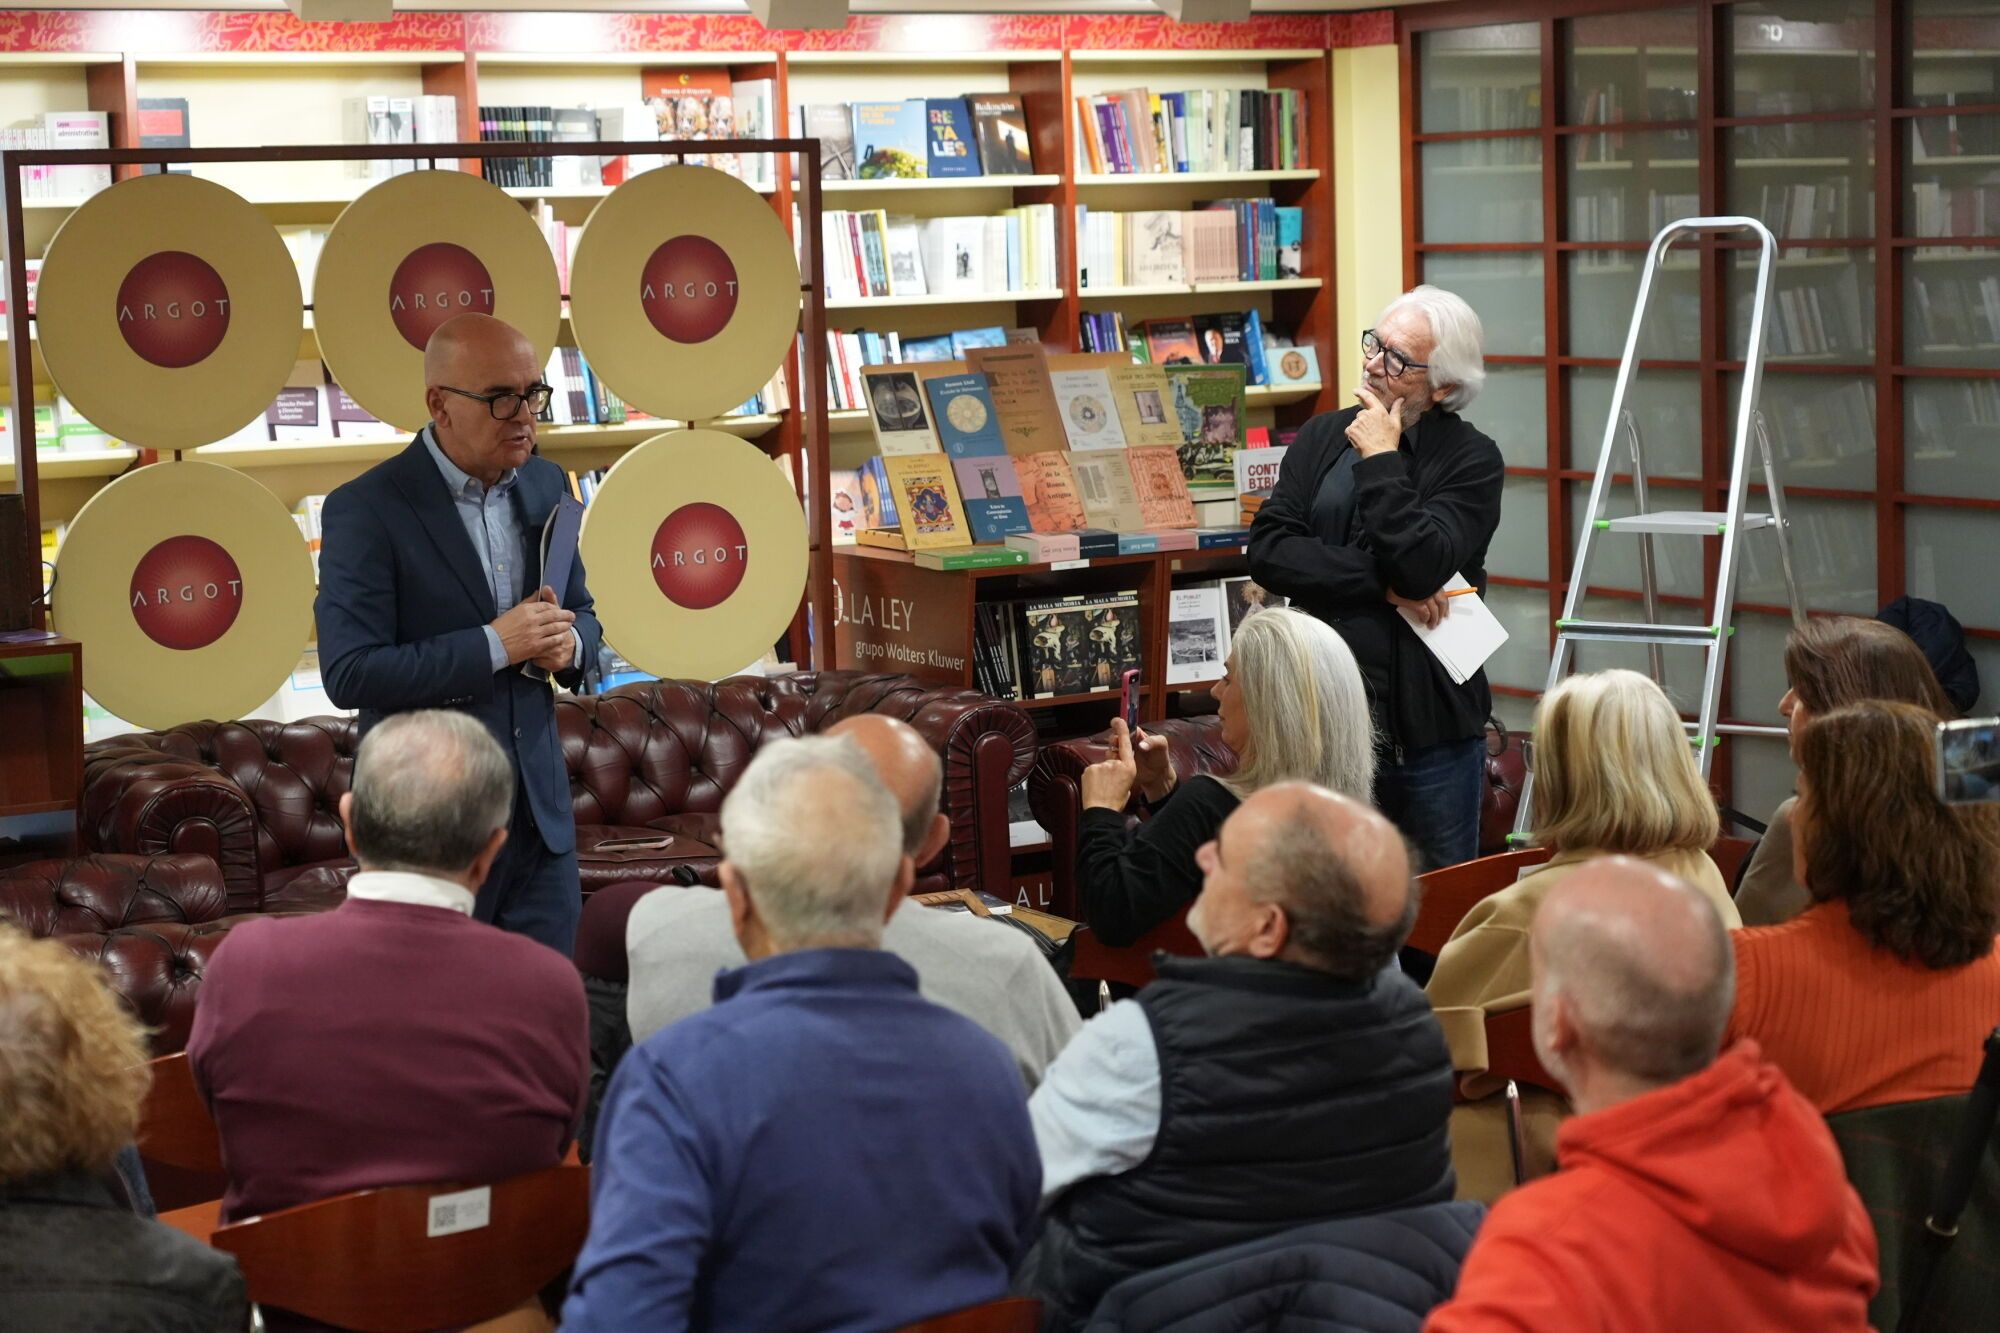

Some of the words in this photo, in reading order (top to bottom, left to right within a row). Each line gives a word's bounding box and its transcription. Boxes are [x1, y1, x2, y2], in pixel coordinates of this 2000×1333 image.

[391, 20, 463, 39] ARGOT
[1000, 22, 1060, 39] ARGOT
[391, 288, 494, 311] ARGOT
[642, 280, 737, 300] ARGOT
[119, 298, 228, 323] ARGOT
[652, 544, 747, 569] ARGOT
[132, 579, 241, 608] ARGOT
[850, 593, 875, 627] LA
[881, 597, 914, 633] LEY
[855, 641, 884, 661] grupo
[885, 642, 926, 665] Wolters
[928, 650, 965, 672] Kluwer
